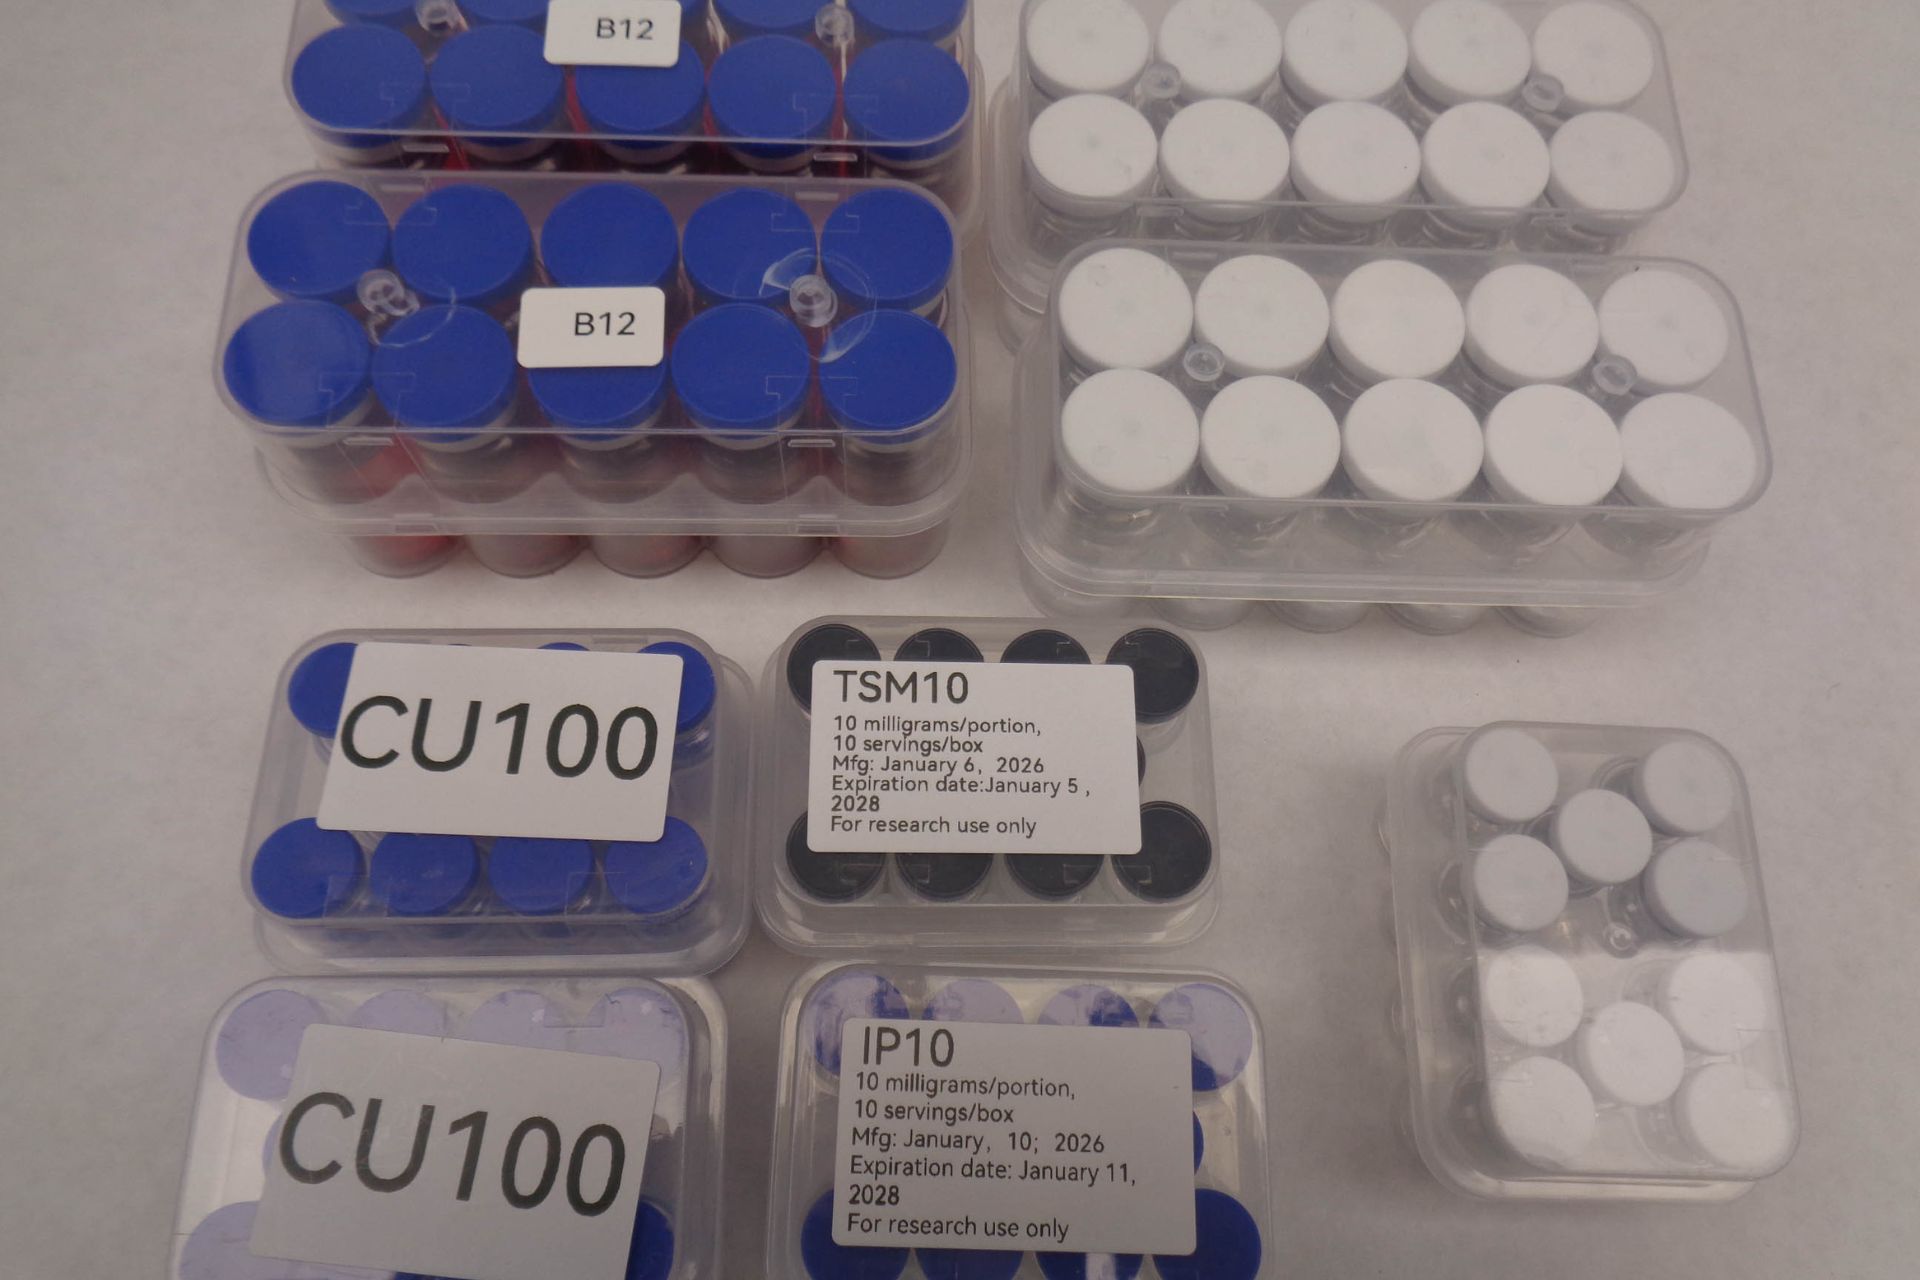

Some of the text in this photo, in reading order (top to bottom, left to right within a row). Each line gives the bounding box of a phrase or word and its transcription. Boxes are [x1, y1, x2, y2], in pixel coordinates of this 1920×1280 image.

[596, 17, 654, 40] B12
[574, 311, 637, 337] B12
[833, 670, 969, 704] TSM10
[340, 695, 659, 781] CU100
[833, 715, 1042, 737] 10 milligrams/portion,
[833, 734, 984, 756] 10 servings/box
[832, 755, 874, 775] Mfg:
[880, 756, 956, 777] January
[996, 757, 1045, 774] 2026
[832, 775, 928, 796] Expiration
[831, 796, 880, 812] 2028
[831, 816, 1037, 838] For research use only
[863, 1026, 954, 1068] IP10
[856, 1072, 1075, 1101] 10 milligrams/portion,
[855, 1099, 1014, 1126] 10 servings/box
[852, 1127, 897, 1152] Mfg:
[1054, 1133, 1104, 1153] 2026
[279, 1091, 626, 1217] CU100
[850, 1155, 1136, 1187] Expiration date: January 11,
[848, 1184, 900, 1206] 2028
[847, 1213, 1069, 1243] For research use only
